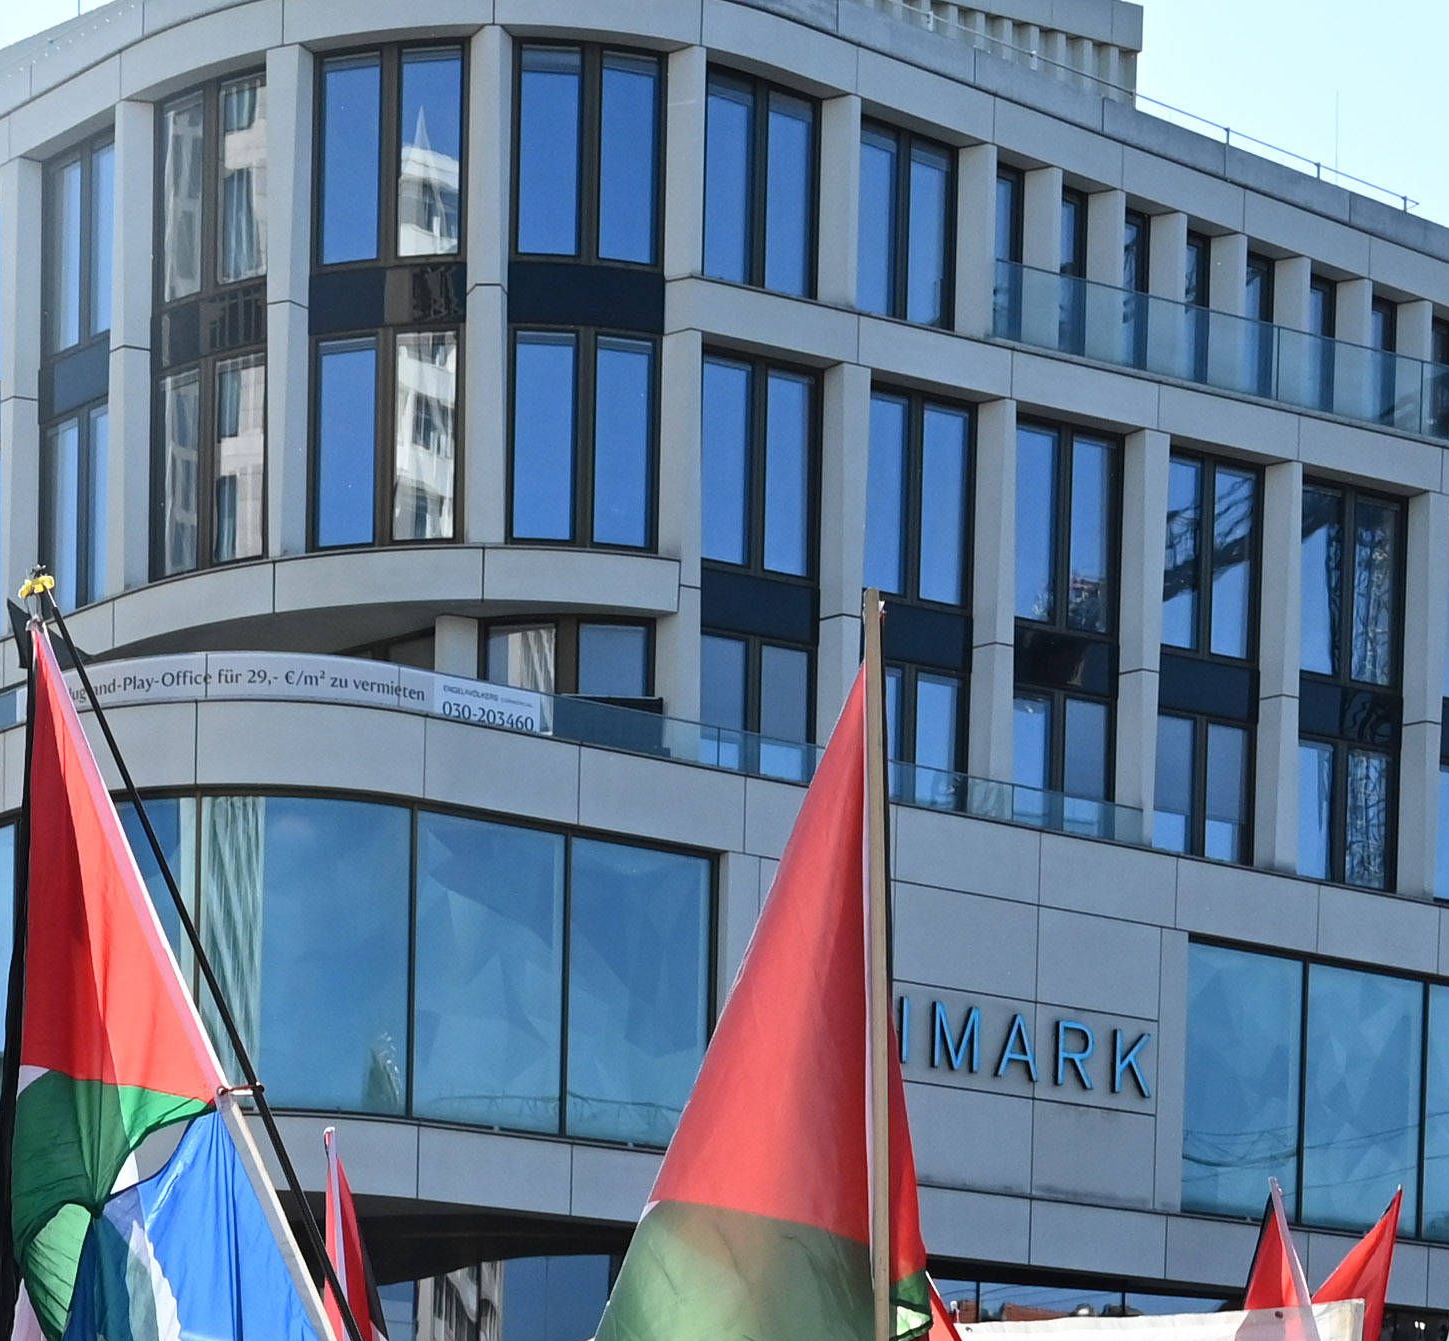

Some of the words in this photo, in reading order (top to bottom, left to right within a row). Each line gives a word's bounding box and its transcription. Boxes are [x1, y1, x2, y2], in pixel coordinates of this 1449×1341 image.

[218, 669, 242, 684] für
[248, 669, 278, 685] 29,-
[285, 670, 325, 686] €/m²
[330, 677, 348, 688] zu
[353, 679, 425, 701] vermieten
[442, 701, 534, 731] 030-203460
[899, 996, 1151, 1098] IMARK
